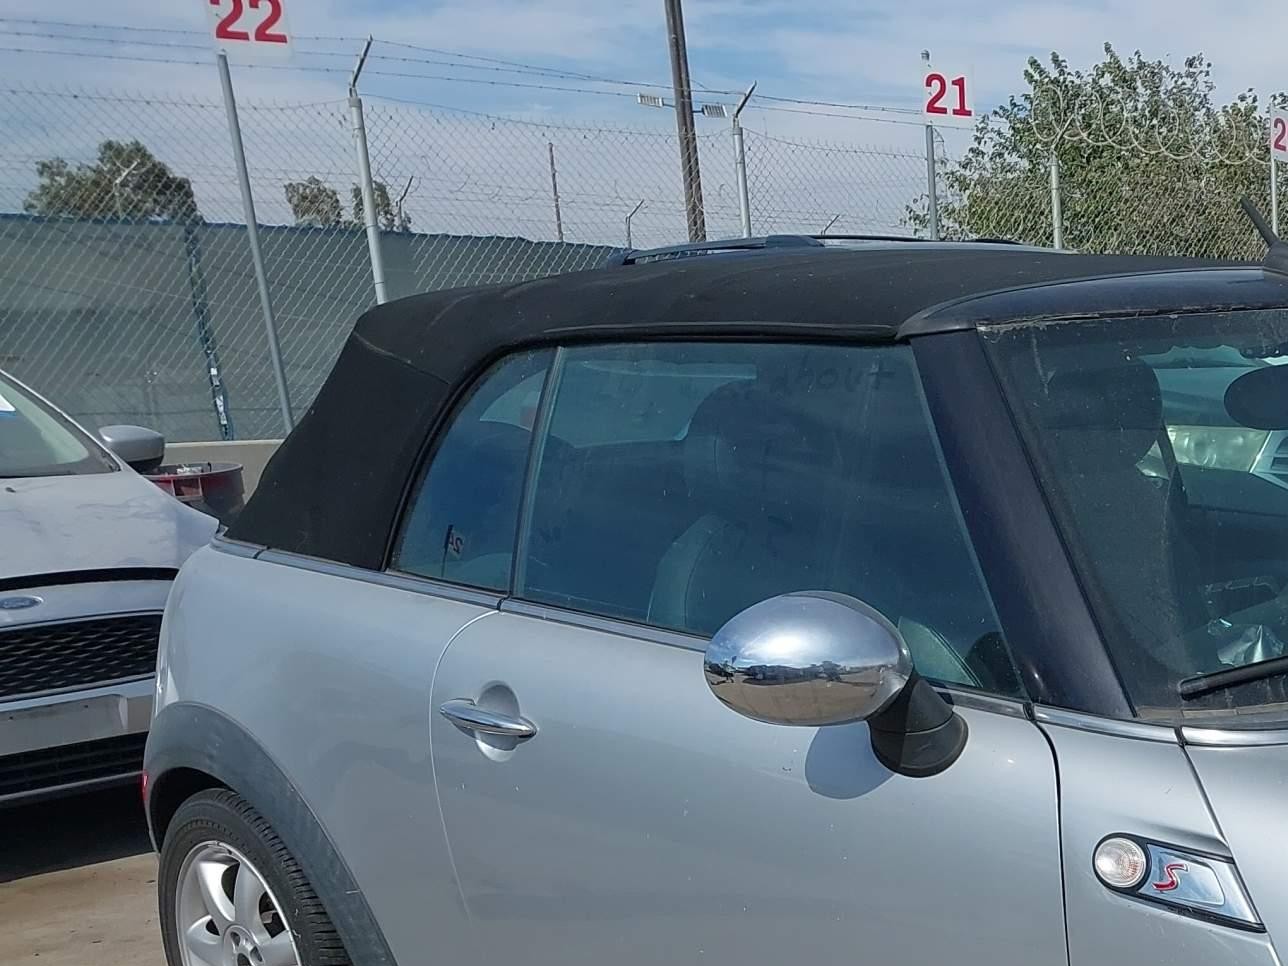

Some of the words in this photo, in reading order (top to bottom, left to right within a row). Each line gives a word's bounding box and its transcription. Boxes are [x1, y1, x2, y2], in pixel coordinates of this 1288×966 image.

[209, 0, 288, 44] 22
[925, 72, 973, 117] 21
[1152, 863, 1189, 891] S
